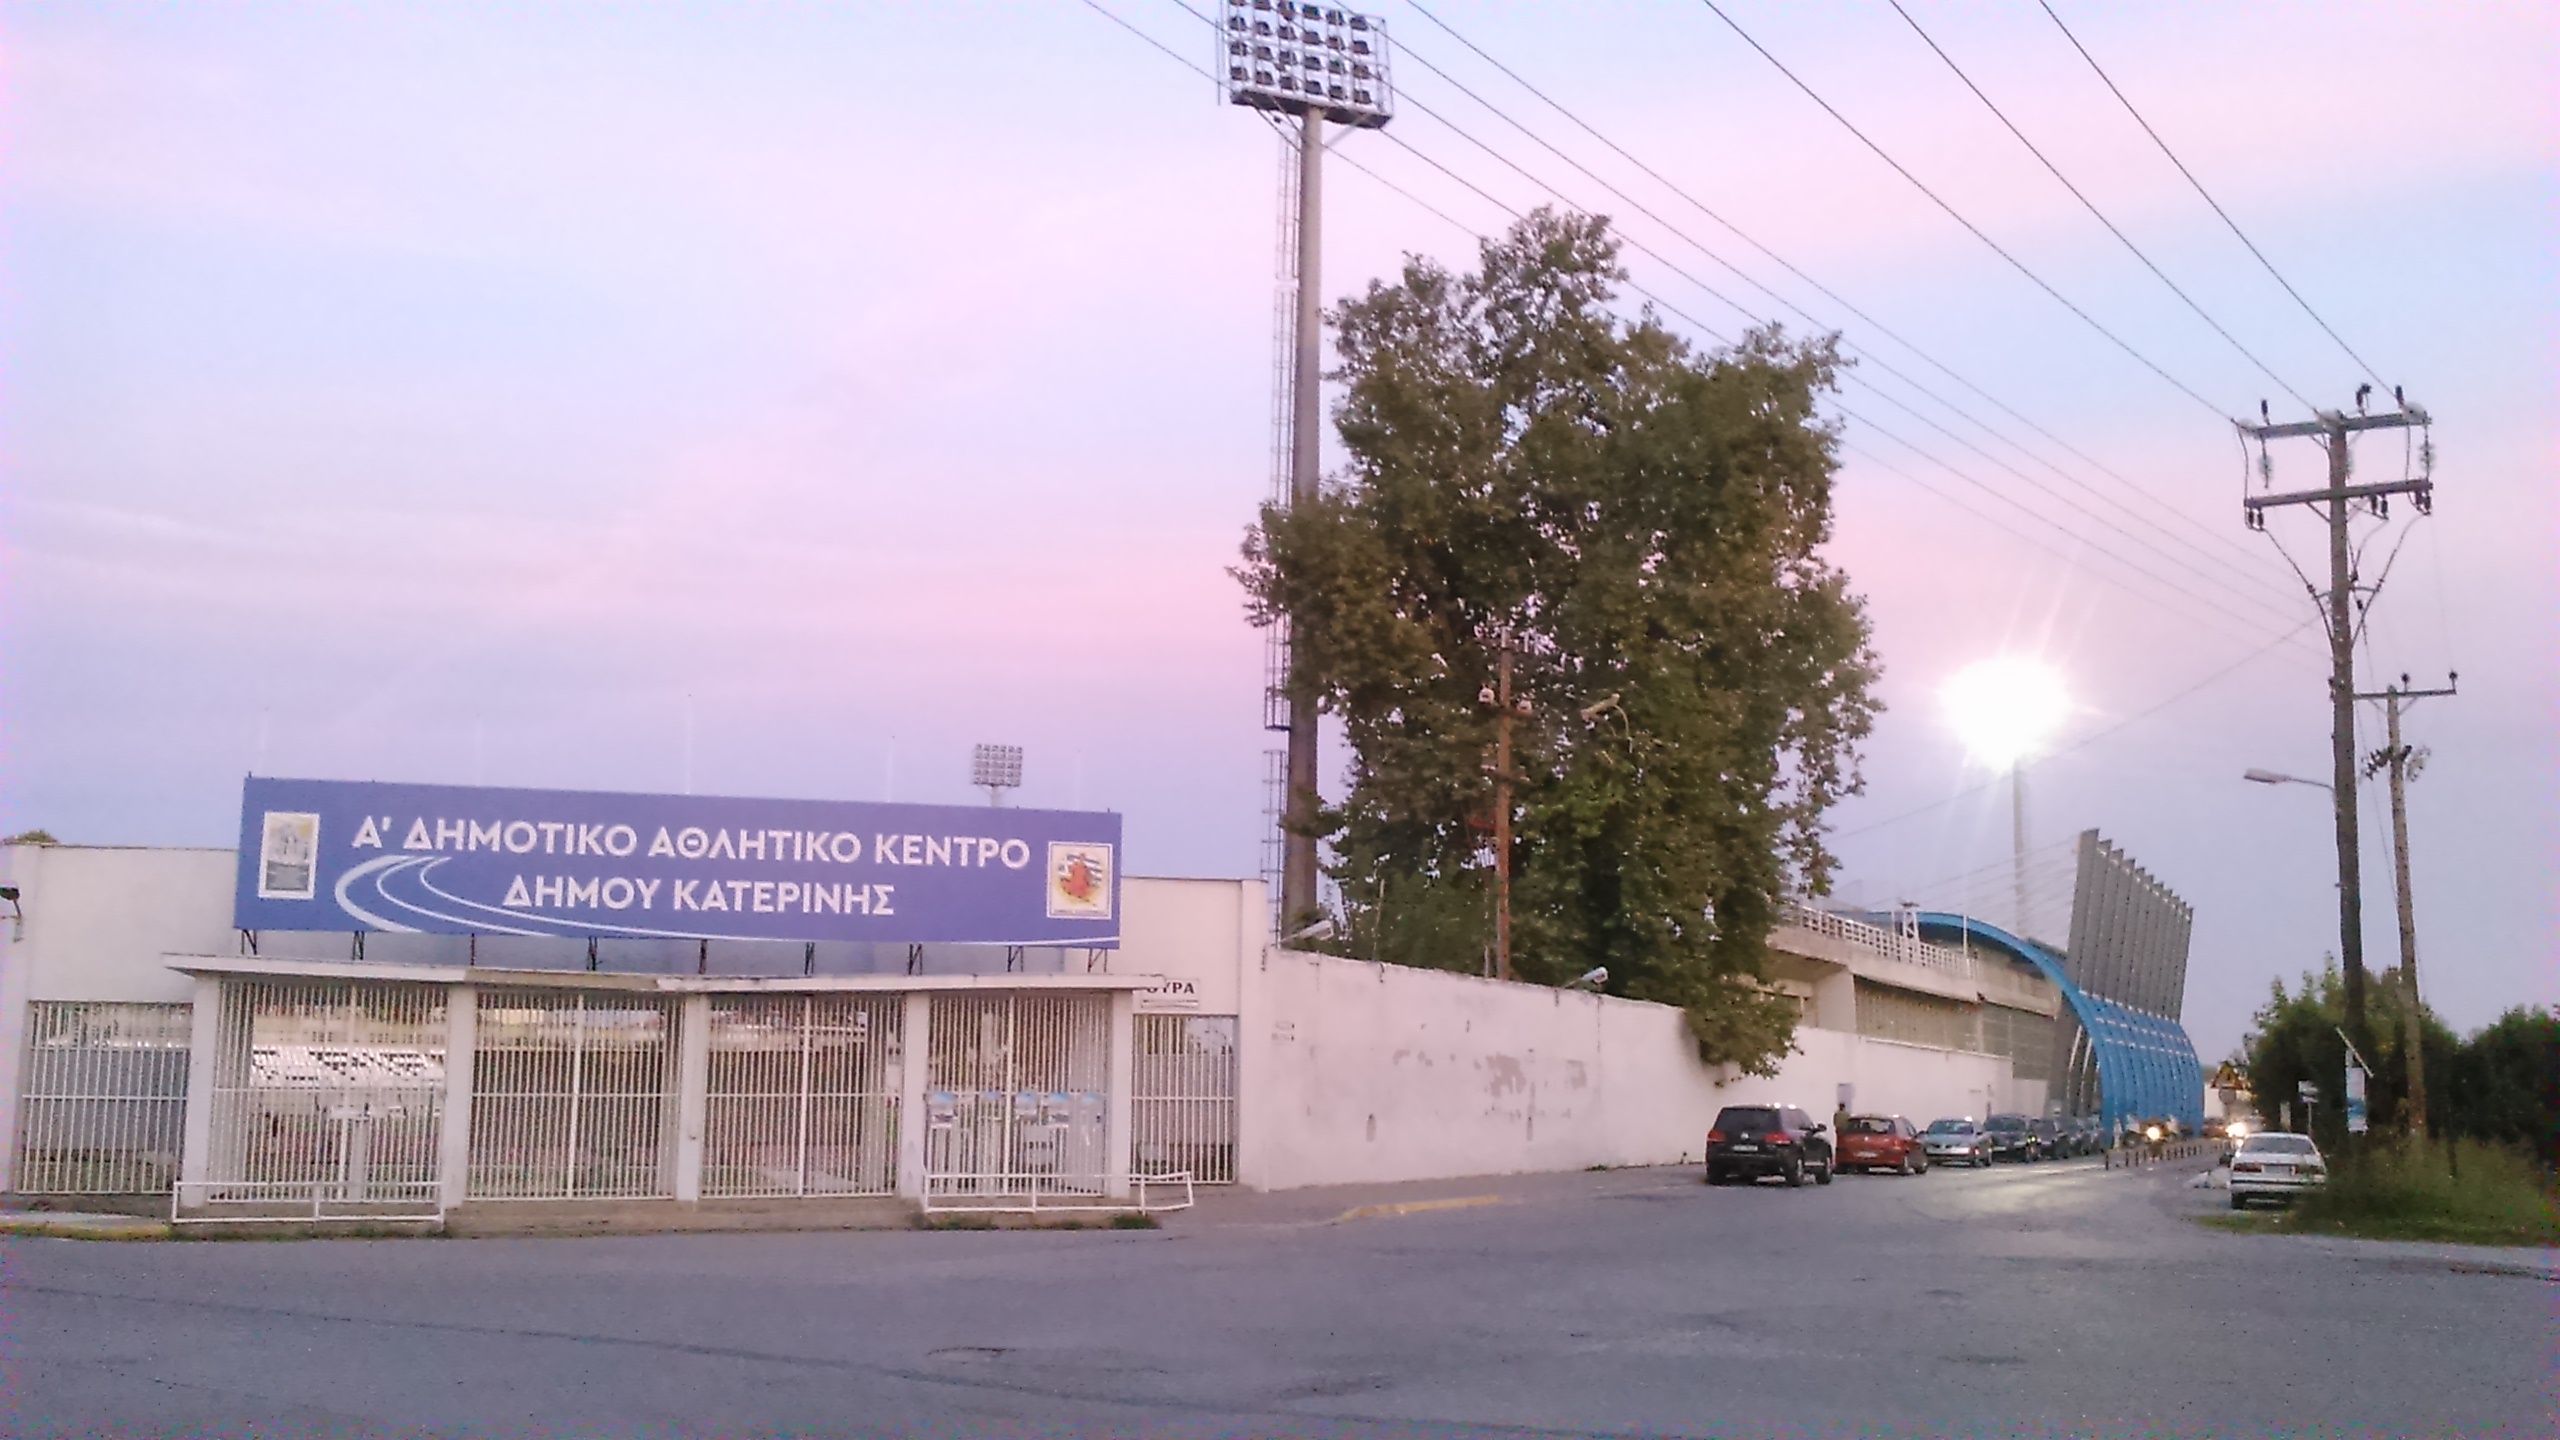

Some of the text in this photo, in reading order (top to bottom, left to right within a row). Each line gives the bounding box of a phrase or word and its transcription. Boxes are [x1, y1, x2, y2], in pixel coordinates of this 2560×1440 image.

[352, 815, 1031, 870] Α' ΔΗΜΟΤΙΚΟ ΑΘΛΗΤΙΚΟ ΚΕΝΤΡΟ
[503, 873, 896, 917] ΔΗΜΟΥ ΚΑΤΕΡΙΝΗΣ
